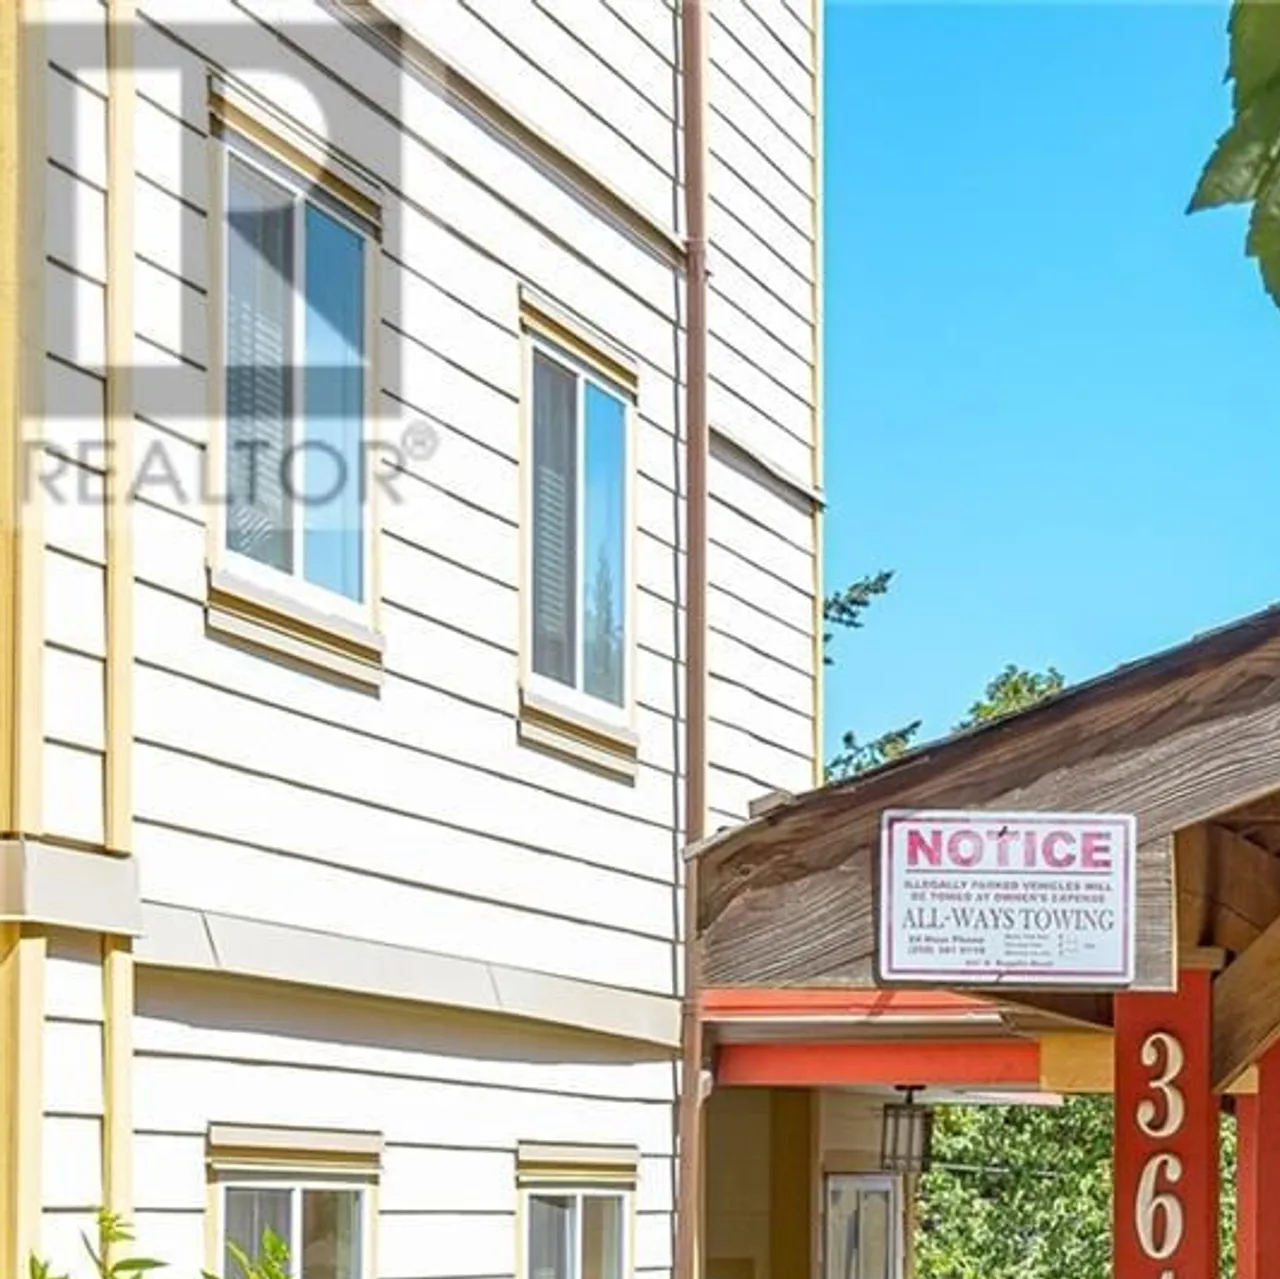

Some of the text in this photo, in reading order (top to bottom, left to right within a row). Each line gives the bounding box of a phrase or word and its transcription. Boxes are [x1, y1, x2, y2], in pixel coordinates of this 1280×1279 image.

[907, 830, 1113, 868] NOTICE
[903, 907, 1114, 932] ALL-WAYS TOWING
